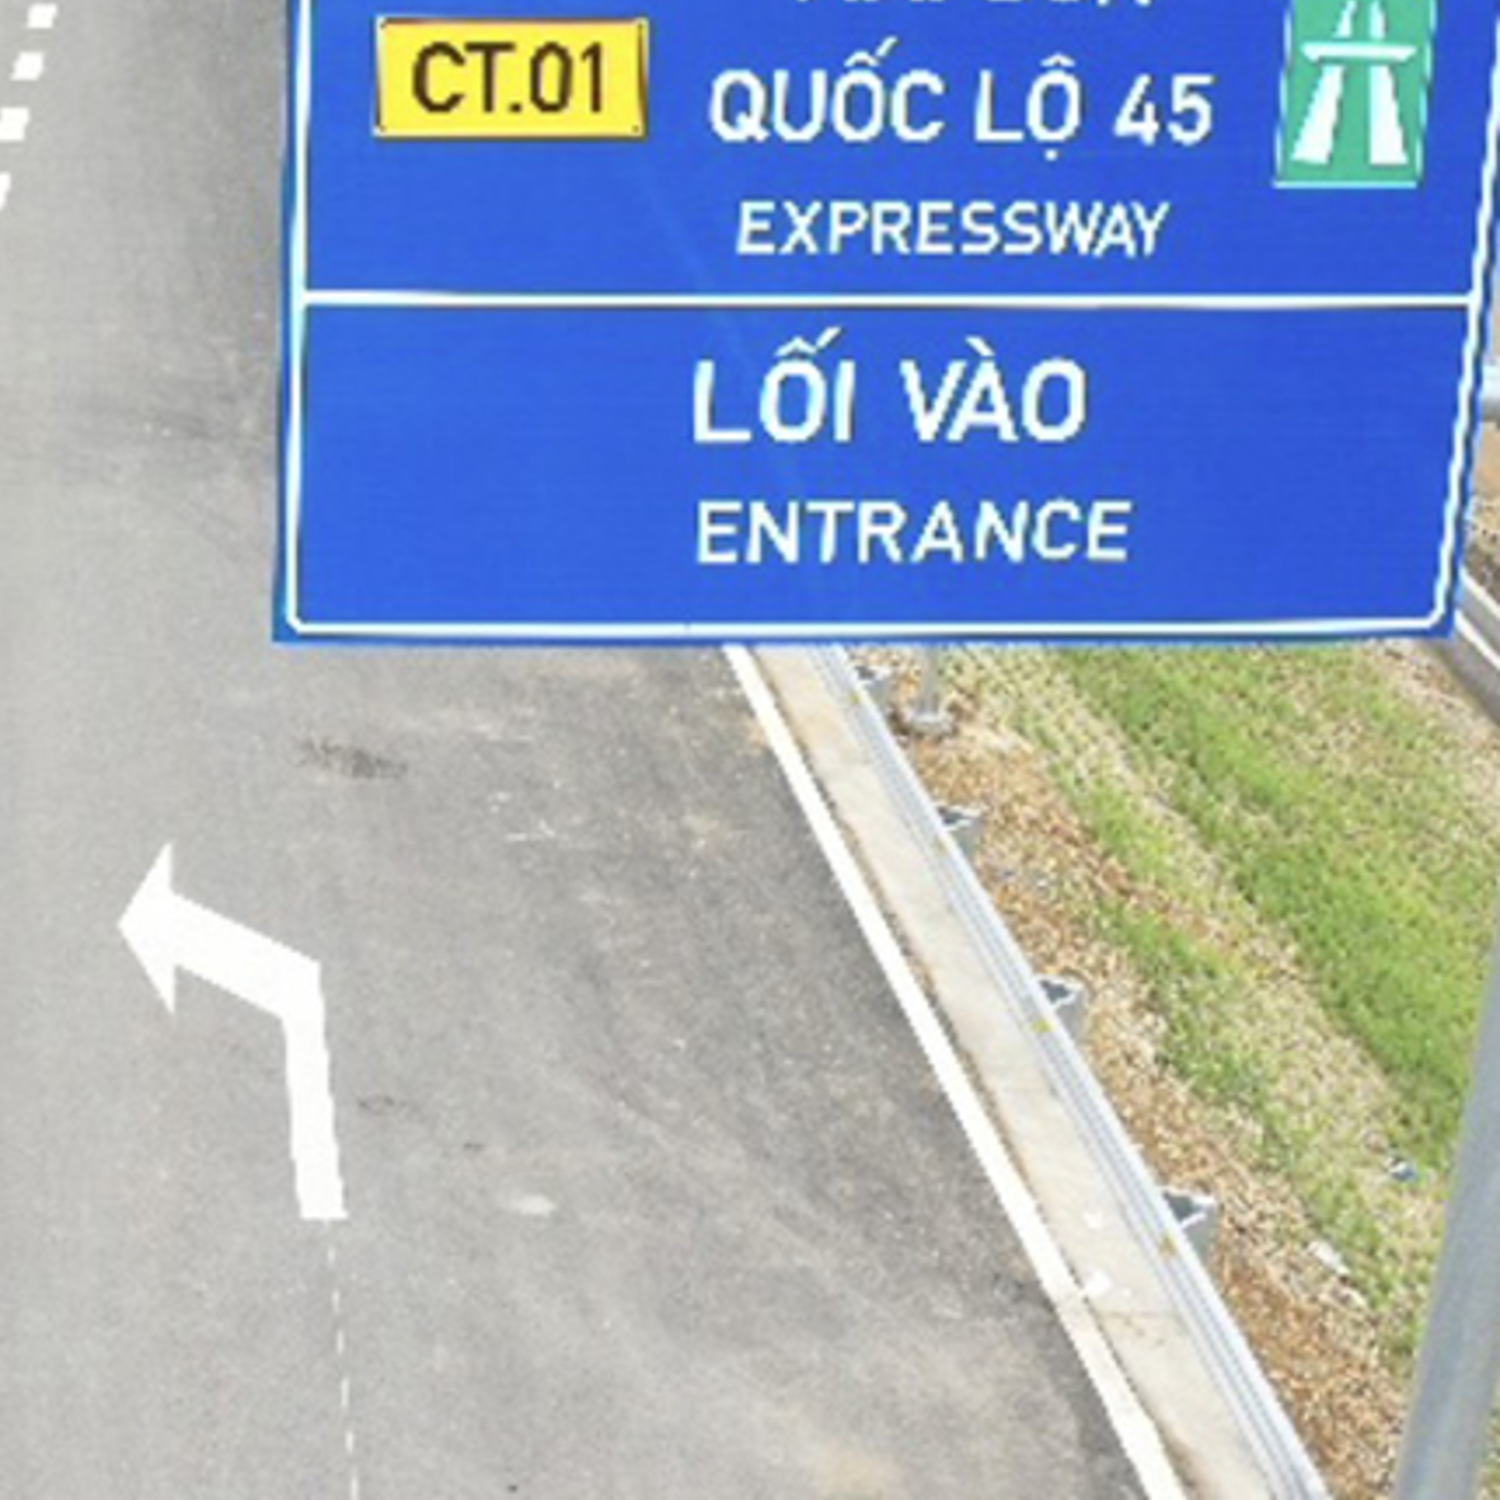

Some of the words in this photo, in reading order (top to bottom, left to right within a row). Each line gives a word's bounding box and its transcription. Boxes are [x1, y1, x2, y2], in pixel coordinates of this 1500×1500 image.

[411, 41, 604, 114] CT.01
[709, 37, 945, 143] QUỐC
[975, 54, 1080, 160] LỘ
[1114, 74, 1214, 146] 45
[737, 201, 1170, 258] EXPRESSWAY
[693, 326, 856, 443] LỐI
[900, 336, 1087, 442] VÀO
[698, 499, 1133, 564] ENTRANCE
